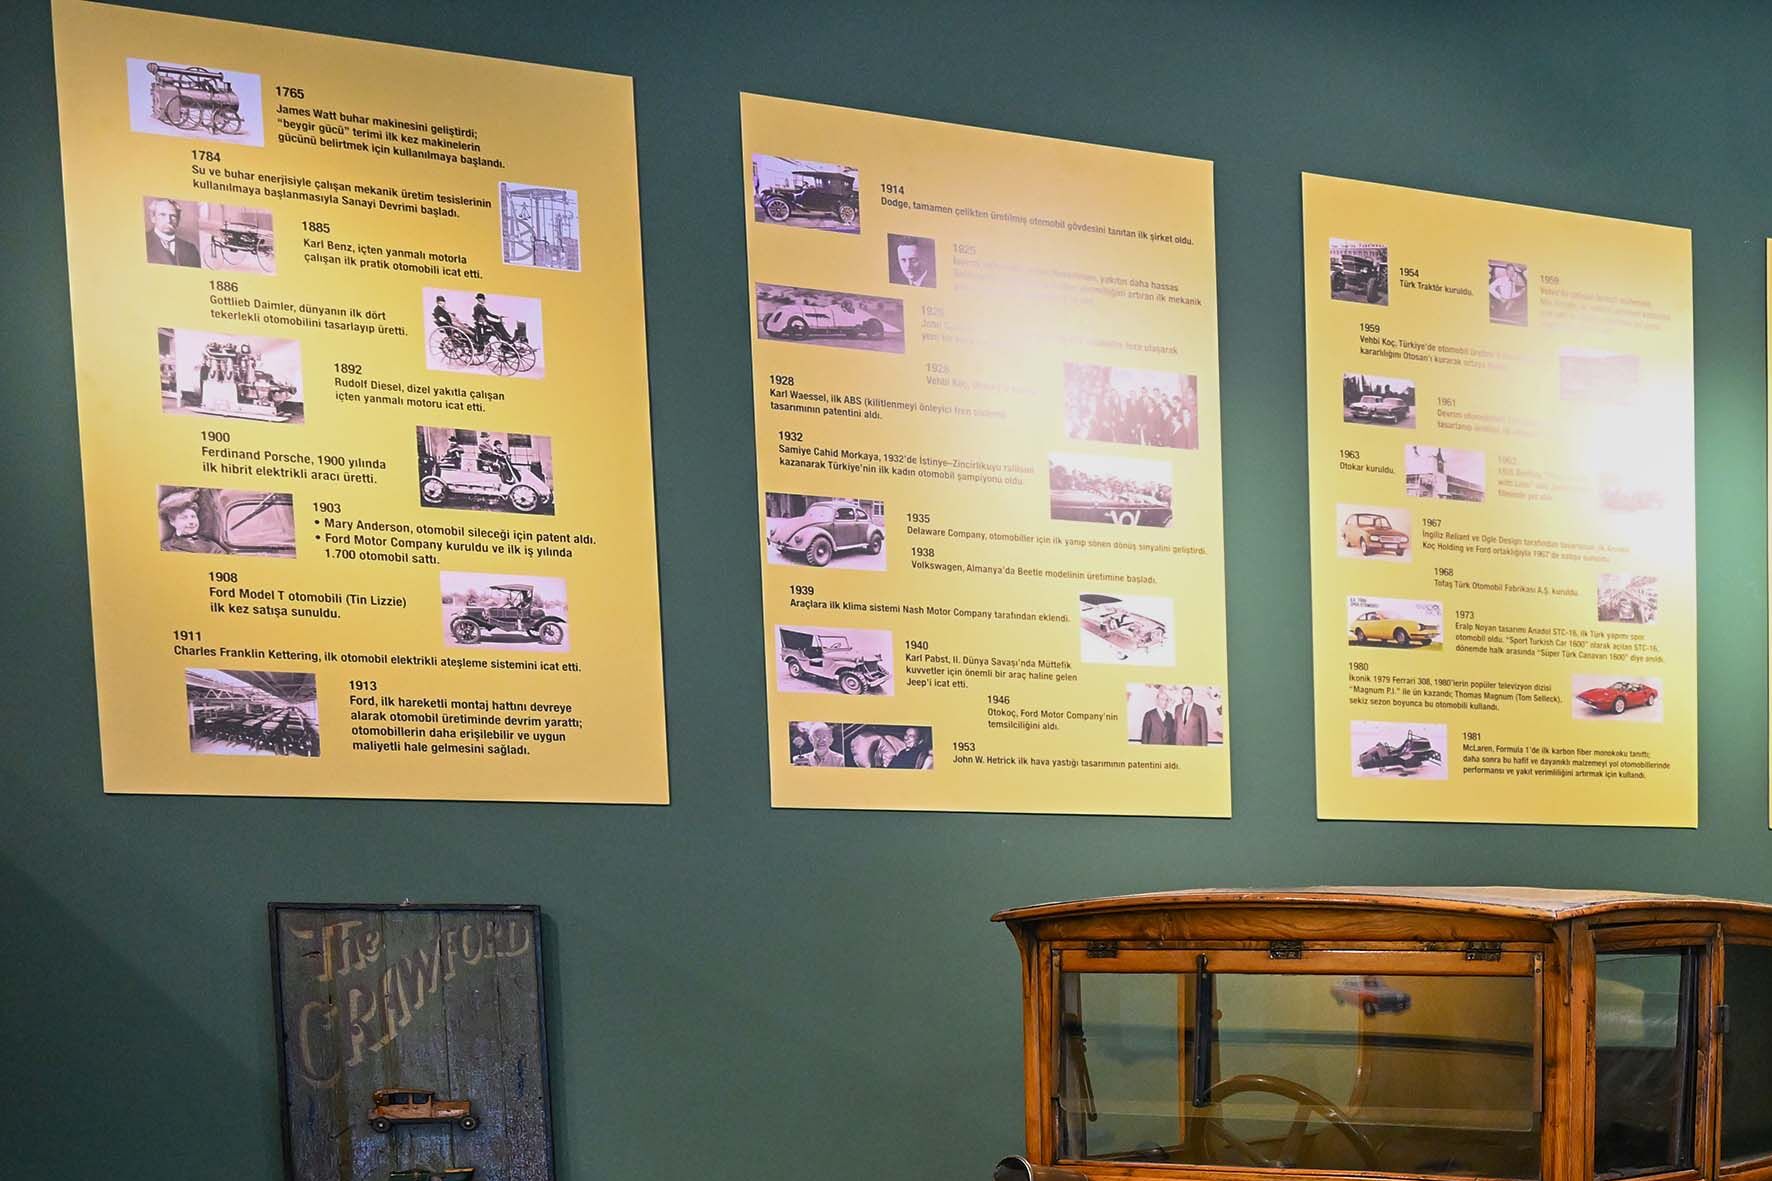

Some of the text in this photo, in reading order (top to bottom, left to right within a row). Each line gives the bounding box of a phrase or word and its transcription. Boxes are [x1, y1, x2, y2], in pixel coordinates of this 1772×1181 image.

[275, 86, 305, 100] 1765
[277, 104, 477, 139] James Watt buhar makinesini geliştirdi;
[191, 149, 221, 163] 1784
[880, 183, 905, 195] 1914
[301, 221, 331, 234] 1885
[303, 238, 467, 265] Karl Benz, içten yanmalı motorla
[304, 253, 483, 280] çalışan ilk pratik otomobili icat etti.
[209, 280, 239, 293] 1886
[333, 363, 363, 375] 1892
[769, 374, 795, 387] 1928
[335, 377, 505, 402] Rudolf Diesel, dizel yakıtla çalışan
[770, 401, 883, 420] tasarımının patentini aldı.
[200, 430, 231, 443] 1900
[778, 430, 804, 442] 1932
[202, 446, 386, 470] Ferdinand Porsche, 1900 yılında
[202, 462, 377, 484] ilk hibrit elektrikli aracı üretti.
[312, 502, 342, 514] 1903
[906, 513, 931, 524] 1935
[325, 548, 440, 565] 1.700 otomobil sattı.
[911, 547, 935, 558] 1938
[208, 571, 238, 583] 1908
[789, 585, 815, 596] 1939
[209, 586, 407, 609] Ford Model T otomobili (Tin Lizzie)
[210, 602, 341, 619] ilk kez satışa sunuldu.
[789, 598, 1071, 623] Araçlara ilk klima sistemi Nash Motor Company tarafından eklendi.
[173, 630, 201, 642] 1911
[905, 640, 929, 651] 1940
[348, 680, 378, 691] 1913
[934, 678, 950, 688] icat
[952, 680, 968, 689] etti.
[987, 694, 1011, 705] 1946
[1020, 708, 1039, 718] Ford
[1040, 709, 1064, 719] Motor
[1042, 721, 1060, 731] aldı.
[952, 741, 976, 752] 1953
[952, 754, 974, 764] John
[974, 755, 985, 764] W.
[986, 756, 1017, 765] Hetrick
[1017, 756, 1029, 766] ilk
[1030, 757, 1050, 766] hava
[290, 919, 386, 982] The
